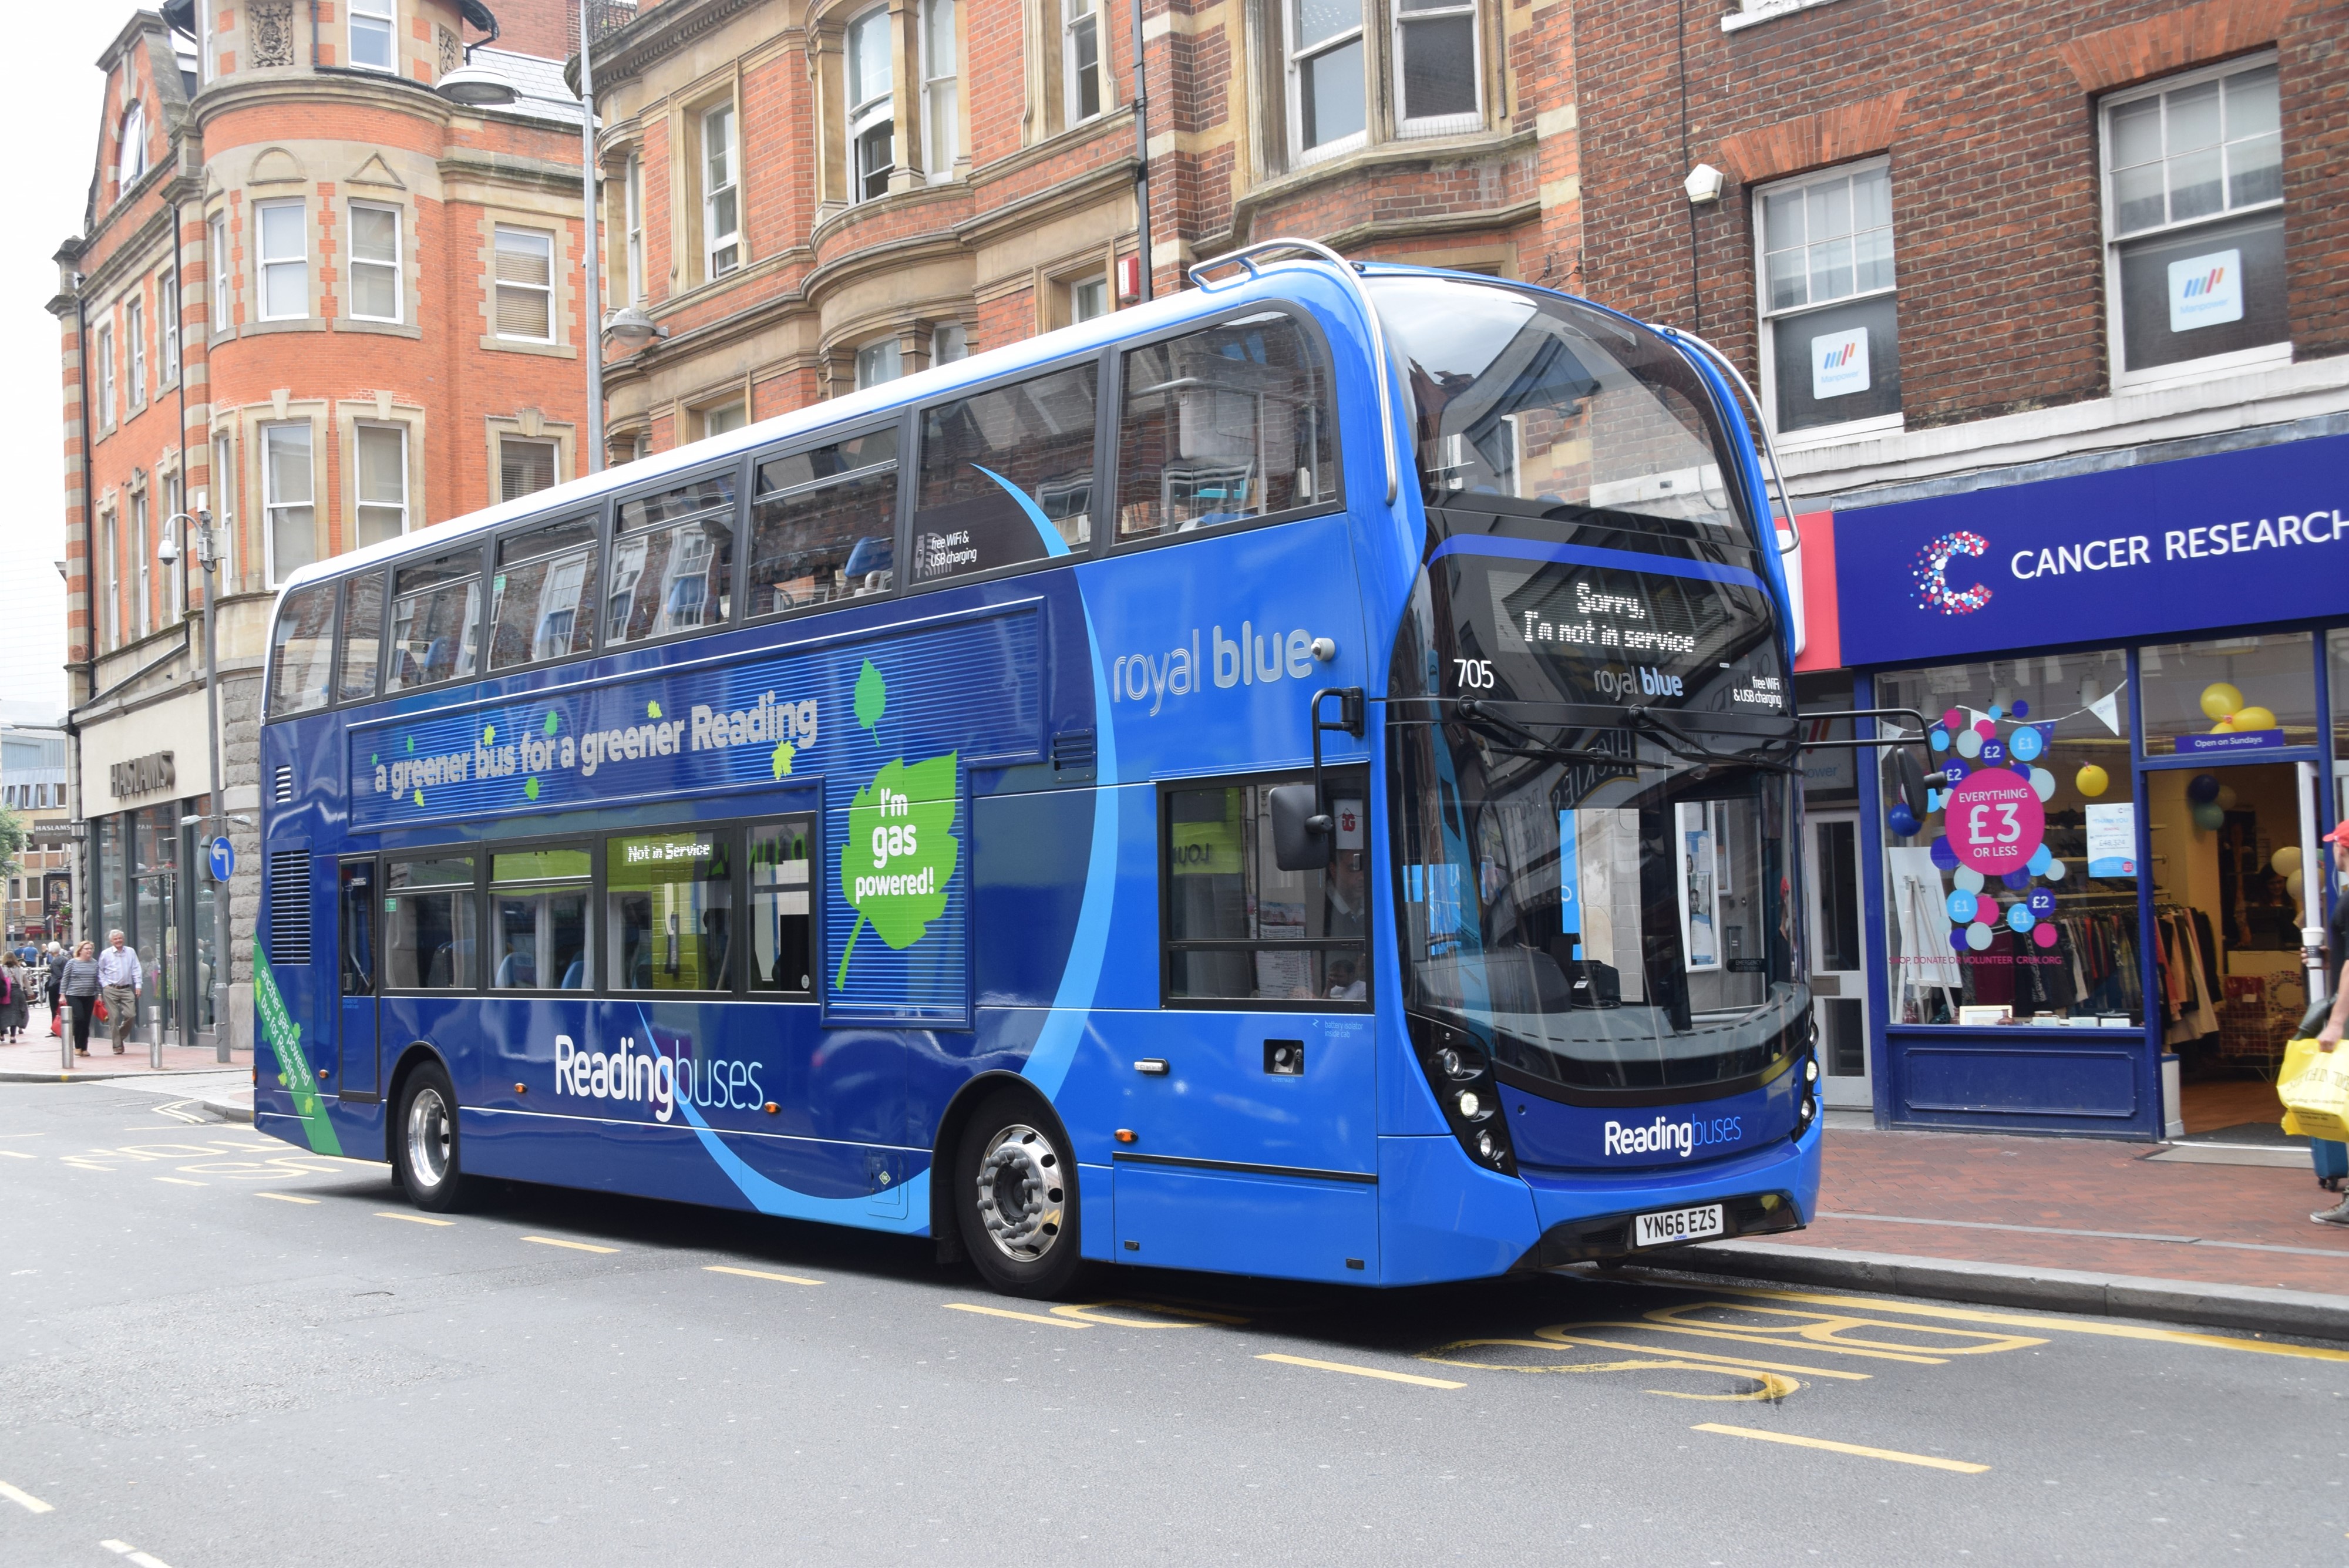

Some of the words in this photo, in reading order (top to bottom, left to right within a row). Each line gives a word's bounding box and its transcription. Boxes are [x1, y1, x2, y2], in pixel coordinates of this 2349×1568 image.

[2179, 298, 2227, 314] Manpower
[1821, 371, 1859, 383] Manpower
[931, 537, 945, 550] free
[946, 531, 963, 547] WiFi
[963, 530, 970, 543] &
[2011, 535, 2151, 579] CANCER
[2165, 510, 2349, 561] RESEARCH
[930, 553, 945, 567] USB
[945, 548, 977, 564] charging
[1576, 583, 1645, 619] Sorry,
[1525, 611, 1552, 642] I'm
[1559, 620, 1595, 644] not
[1602, 625, 1618, 645] in
[1624, 631, 1695, 652] service
[1113, 628, 1200, 716] royal
[1213, 620, 1313, 688] blue
[1453, 658, 1495, 689] 705
[1594, 664, 1638, 702] royal
[1640, 666, 1684, 697] blue
[1752, 675, 1766, 689] free
[1765, 677, 1781, 690] WiFi
[1733, 688, 1740, 701] &
[1740, 689, 1754, 702] USB
[1755, 691, 1782, 708] charging
[375, 764, 387, 792] a
[391, 751, 472, 800] greener
[475, 740, 516, 779] bus
[520, 732, 556, 773] for
[560, 736, 575, 768] a
[580, 718, 685, 777] greener
[691, 690, 817, 751] Reading
[1984, 745, 2001, 759] £2
[2017, 736, 2035, 750] £1
[2195, 739, 2216, 749] Open
[2230, 735, 2263, 745] Sundays
[110, 750, 176, 798] HASLAMS
[1946, 768, 1962, 782] £2
[880, 788, 908, 817] I'm
[1958, 788, 2028, 803] EVERYTHING
[1968, 803, 2021, 844] £3
[628, 845, 649, 862] Not
[652, 847, 662, 859] in
[665, 843, 710, 860] Service
[872, 825, 917, 869] gas
[1973, 847, 1990, 857] OR
[1993, 846, 2018, 856] LESS
[855, 866, 934, 904] powered!
[1954, 900, 1970, 912] £1
[2032, 896, 2050, 909] £2
[2013, 911, 2029, 924] £1
[1914, 956, 1947, 964] DONATE
[1948, 956, 1961, 964] OR
[1963, 956, 2013, 964] VOLUNTEER
[2016, 956, 2062, 964] CRUK.ORG
[1324, 1021, 1344, 1031] battery
[1344, 1021, 1364, 1030] isolator
[261, 994, 272, 1021] bus
[269, 1017, 280, 1038] for
[277, 1034, 298, 1090] Reading
[277, 1011, 290, 1035] gas
[286, 1033, 311, 1086] powered
[1644, 1214, 1684, 1239] YN66
[1688, 1208, 1717, 1233] EZS
